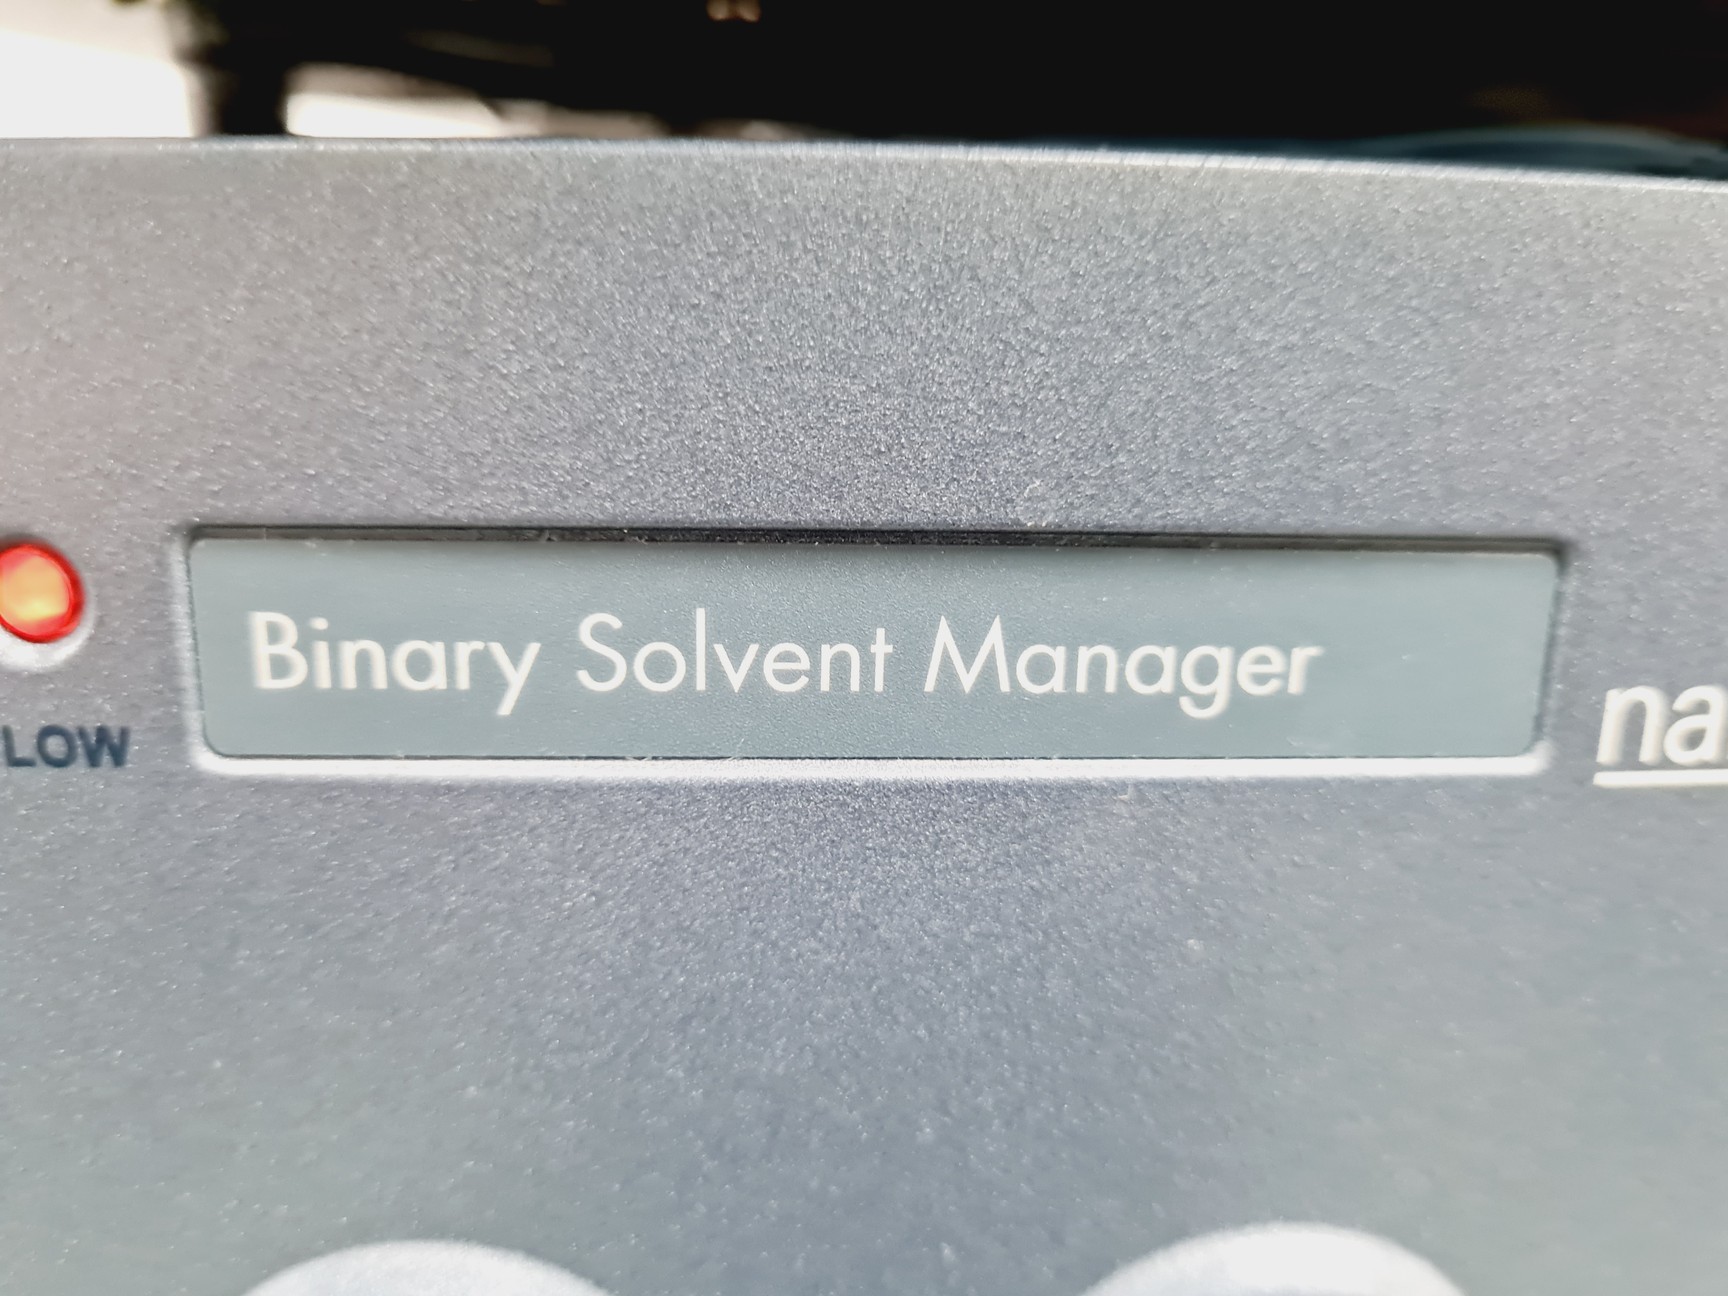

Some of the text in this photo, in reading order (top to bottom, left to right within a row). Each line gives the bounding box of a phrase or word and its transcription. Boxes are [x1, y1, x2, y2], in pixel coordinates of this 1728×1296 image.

[248, 608, 1324, 718] Binary Solvent Manager
